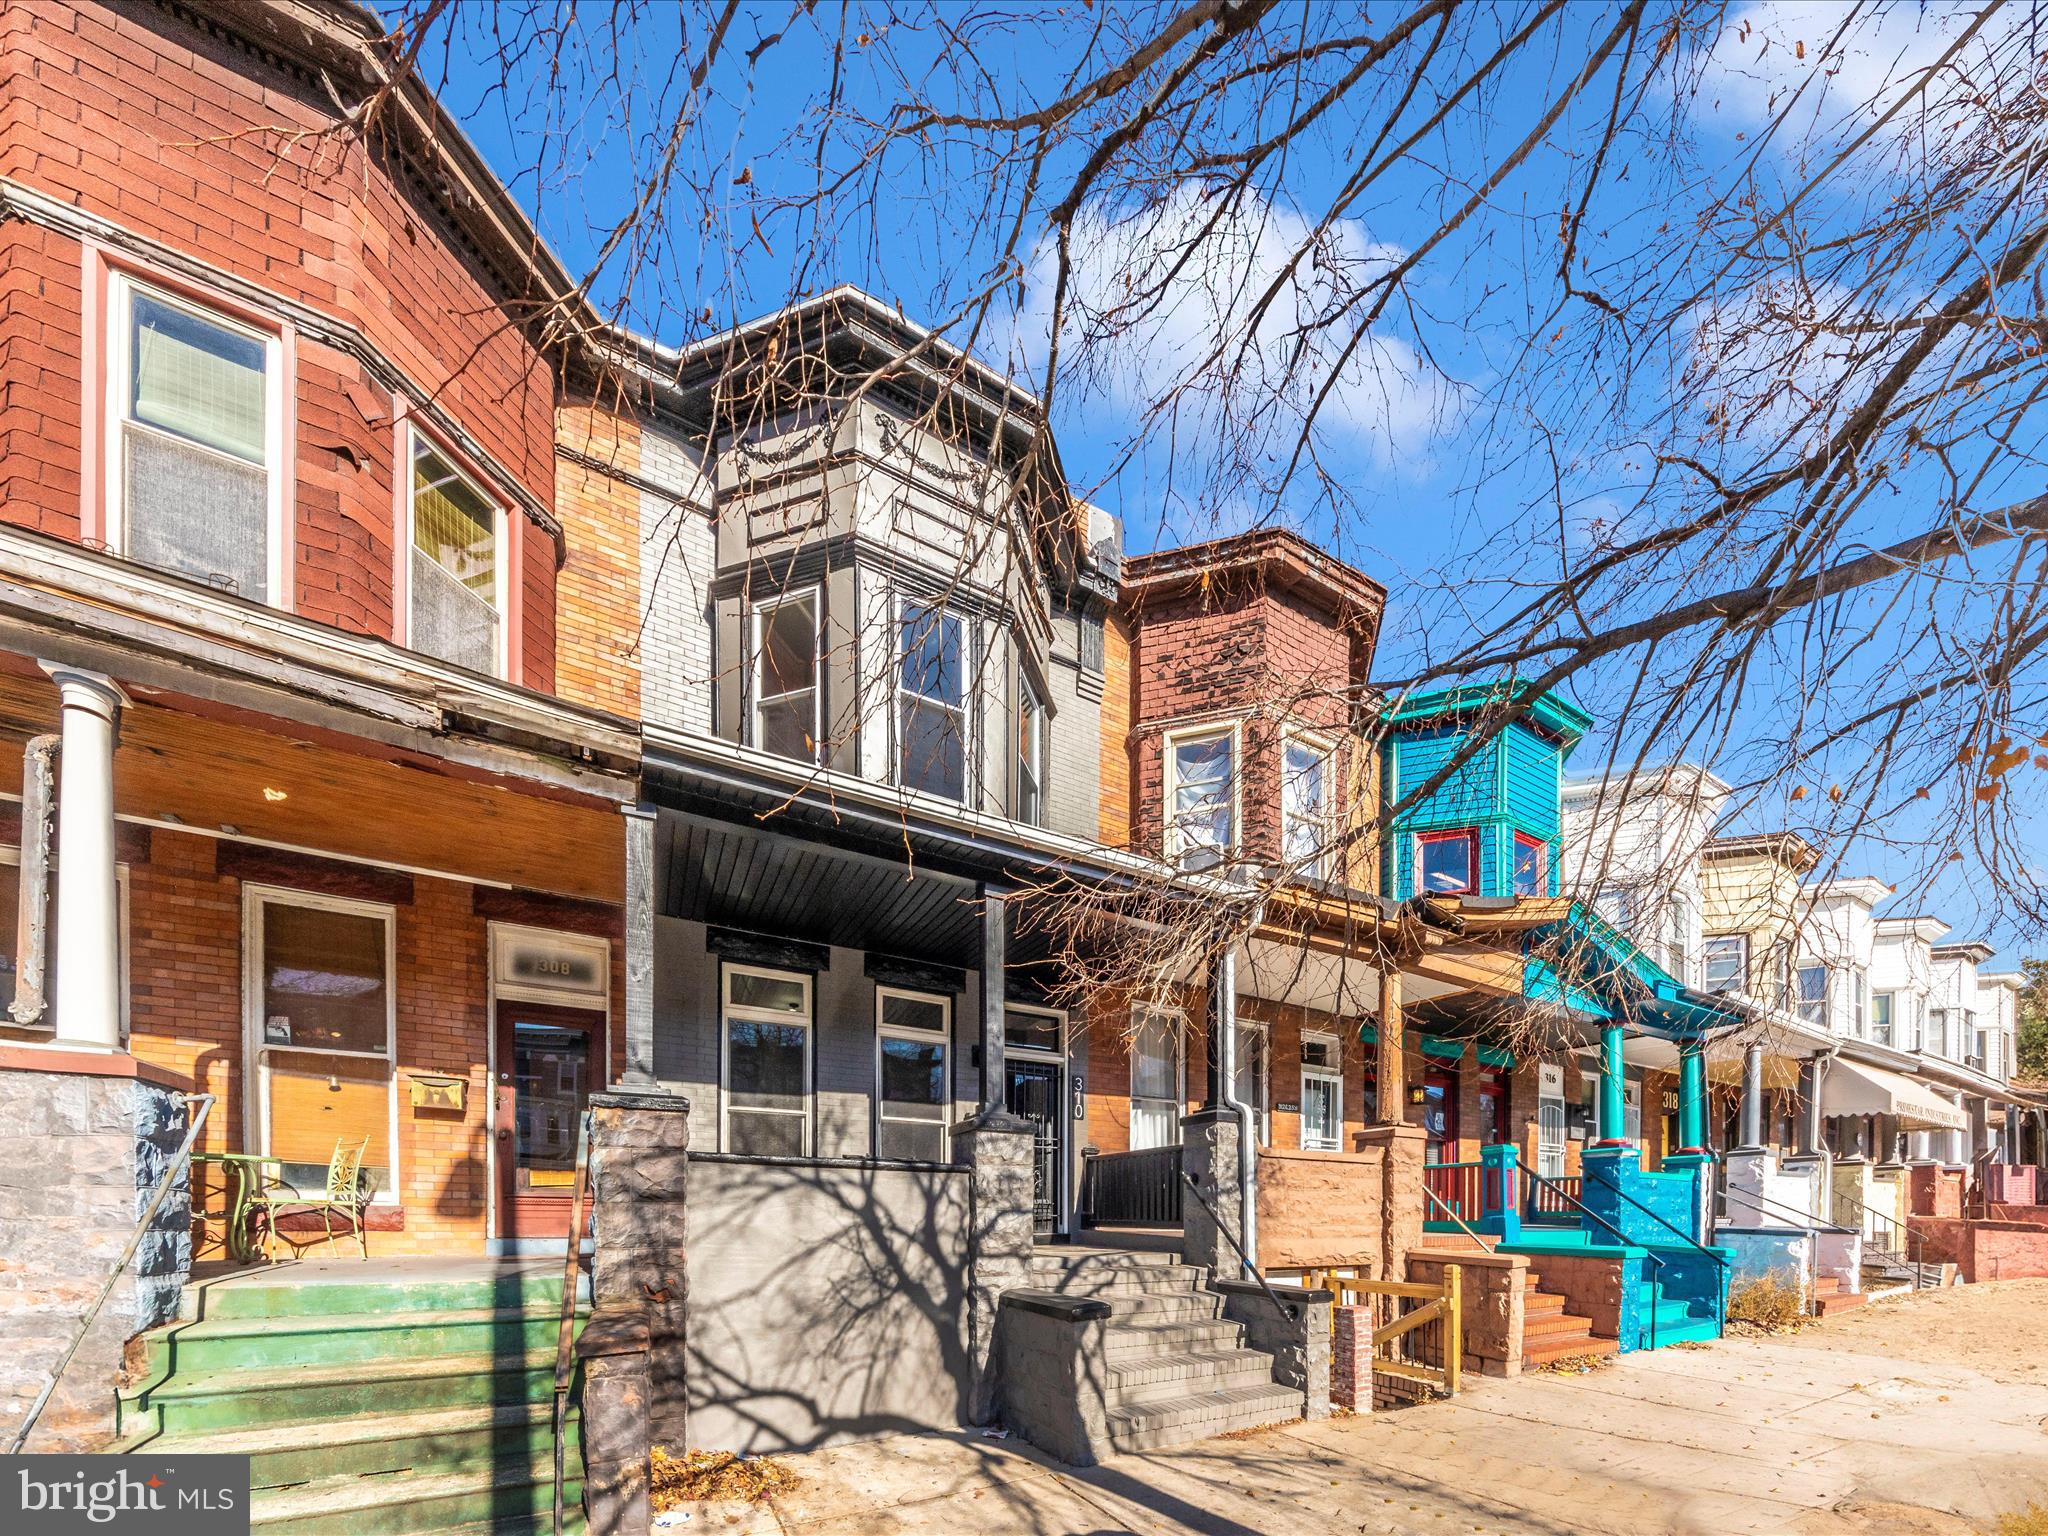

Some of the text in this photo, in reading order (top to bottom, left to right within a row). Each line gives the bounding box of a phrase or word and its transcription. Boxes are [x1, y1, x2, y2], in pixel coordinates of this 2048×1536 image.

[538, 960, 570, 975] 308
[1544, 1072, 1557, 1084] 316
[1074, 1077, 1083, 1118] 310
[1662, 1091, 1679, 1110] 318
